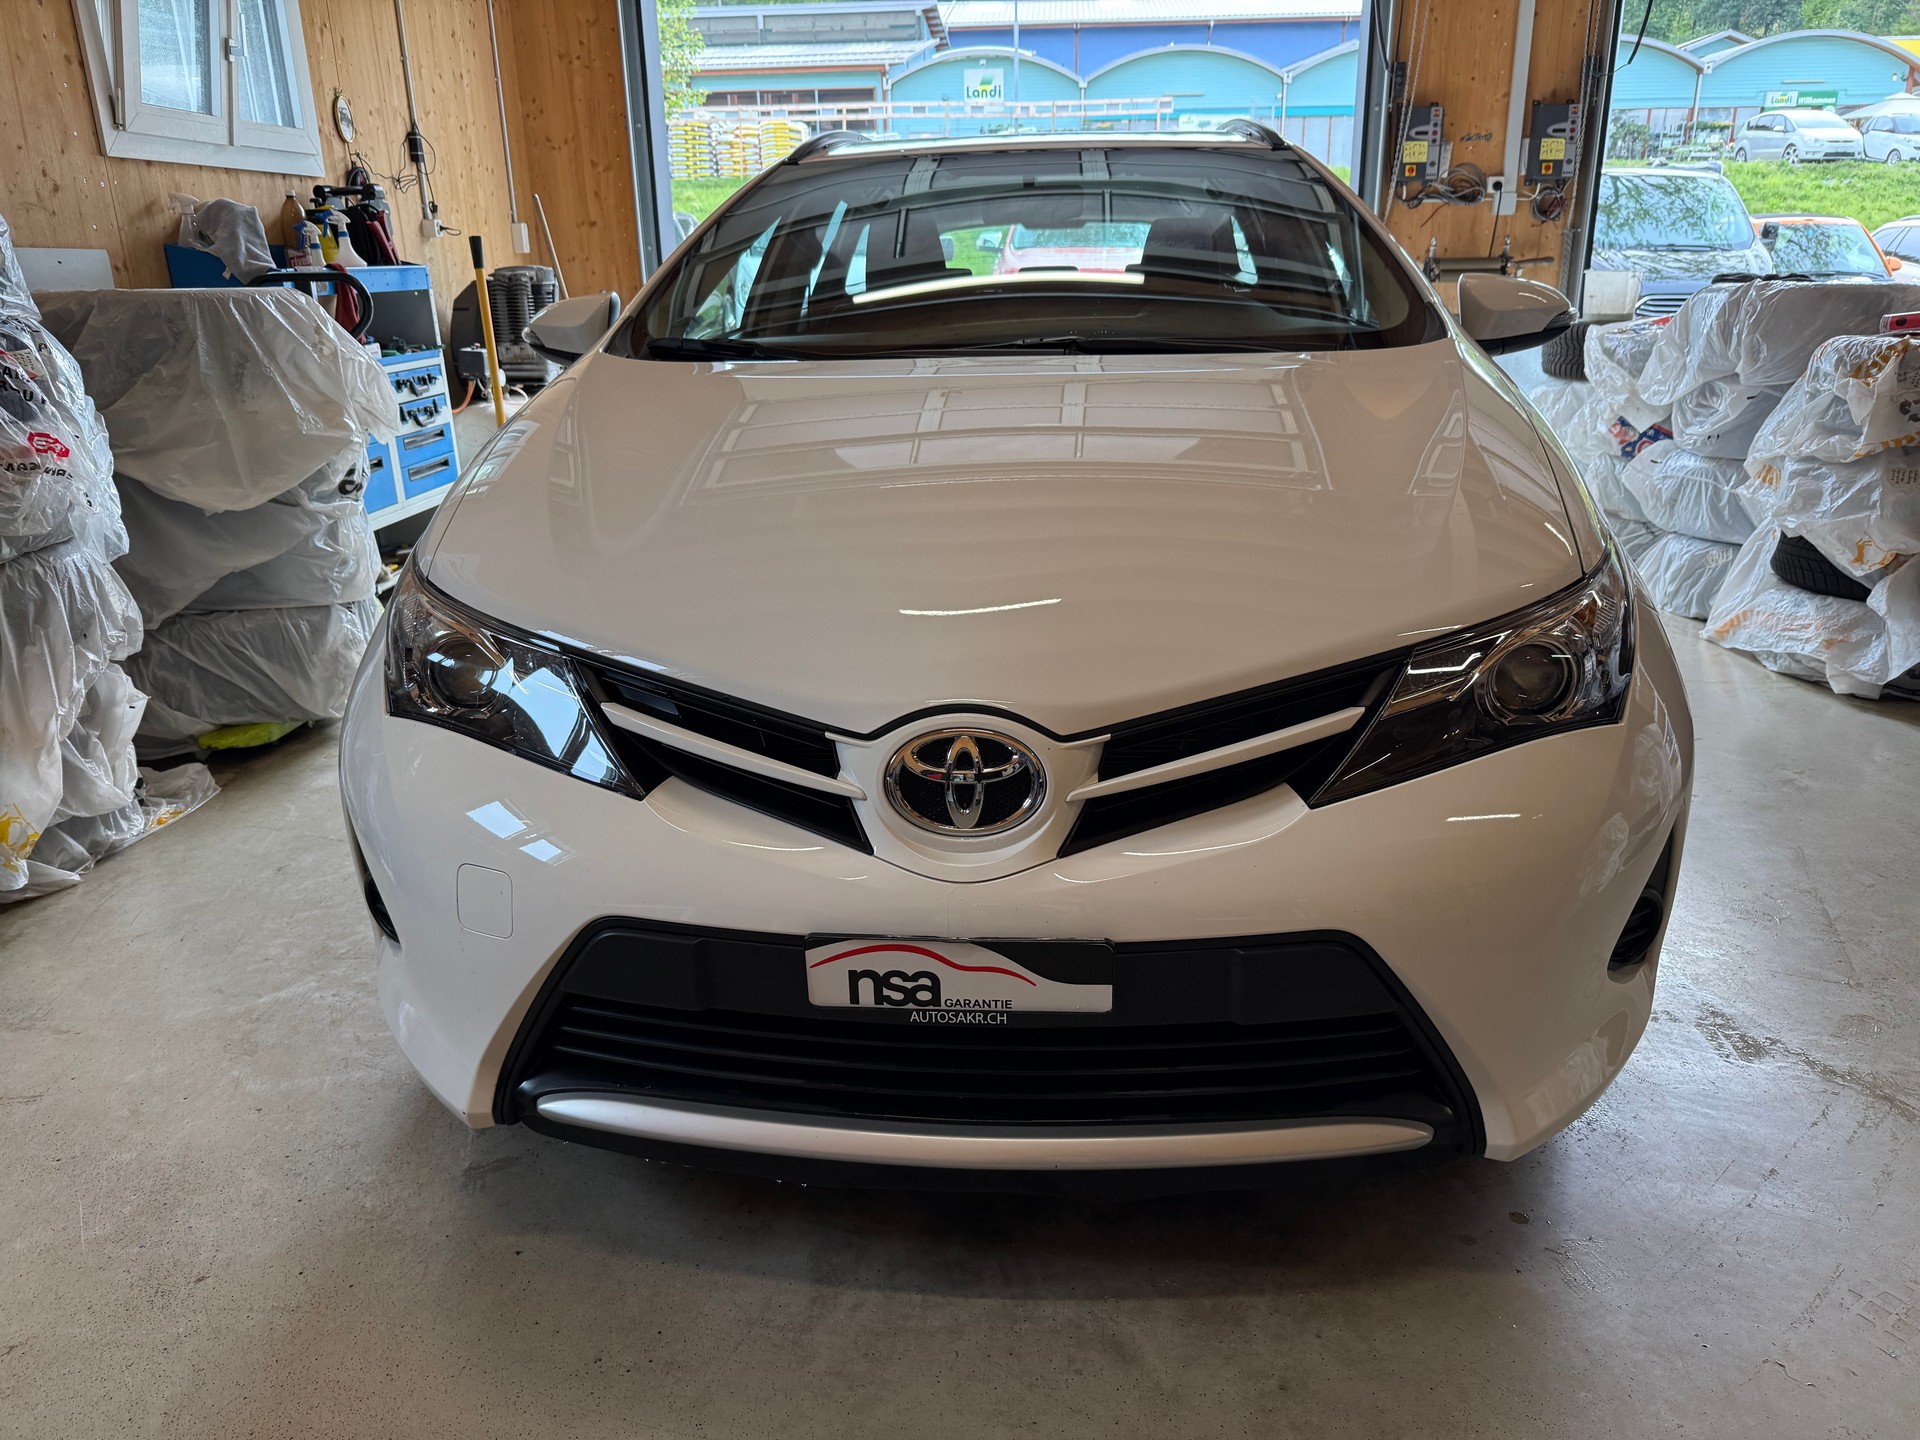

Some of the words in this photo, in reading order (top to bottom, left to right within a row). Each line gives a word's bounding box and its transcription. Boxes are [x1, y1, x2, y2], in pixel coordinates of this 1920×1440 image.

[966, 85, 1002, 98] Landi
[1770, 95, 1793, 104] Landi
[1798, 96, 1837, 105] Willkommen
[848, 969, 941, 1007] nsa
[944, 998, 1013, 1009] GARANTIE
[910, 1011, 1007, 1024] AUTOSAKR.CH
